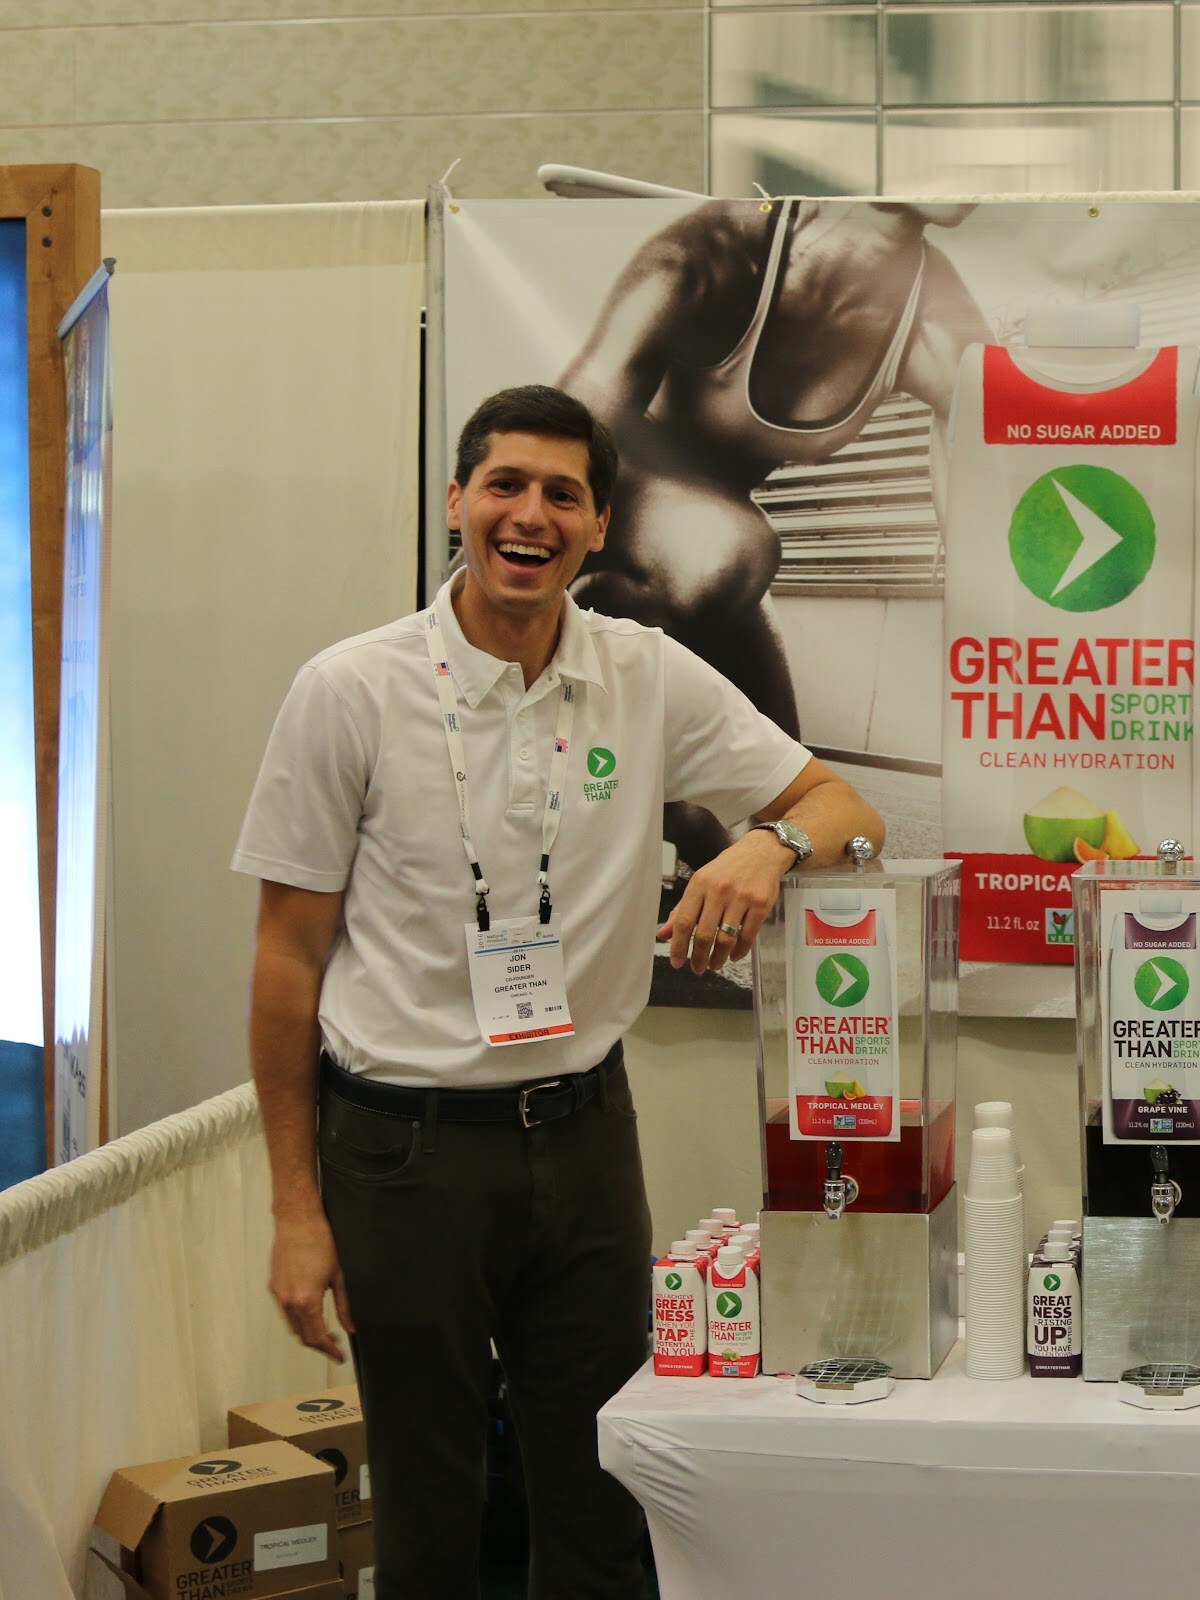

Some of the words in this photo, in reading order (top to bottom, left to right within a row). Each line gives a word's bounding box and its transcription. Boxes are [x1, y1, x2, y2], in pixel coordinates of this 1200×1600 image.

[1007, 424, 1031, 439] NO
[1036, 424, 1095, 440] SUGAR
[1101, 424, 1161, 440] ADDED
[952, 692, 1105, 742] THAN
[980, 752, 1047, 769] CLEAN
[1053, 752, 1175, 770] HYDRATION
[585, 790, 611, 801] THAN
[975, 872, 1072, 892] TROPICA
[987, 916, 1011, 930] 11.2
[1027, 919, 1040, 930] oz
[510, 954, 526, 962] JON
[507, 964, 531, 973] SIDER
[494, 982, 527, 993] GREATER
[529, 980, 547, 988] THAN
[795, 1016, 888, 1035] GREATER
[509, 1029, 550, 1040] EXHIBITOR
[797, 1037, 854, 1054] THAN
[855, 1037, 891, 1045] SPORTS
[855, 1047, 888, 1055] DRINK
[1114, 1040, 1172, 1058] THAN
[1152, 1061, 1198, 1069] HYDRATION
[808, 1102, 849, 1110] TROPICAL
[656, 1298, 694, 1310] GREAT
[1033, 1295, 1072, 1306] GREAT
[656, 1309, 695, 1322] NESS
[1033, 1306, 1072, 1318] NESS
[710, 1320, 752, 1331] GREATER
[656, 1327, 689, 1341] TAP
[711, 1330, 735, 1341] THAN
[1034, 1325, 1067, 1345] UP
[656, 1340, 695, 1348] POTENTIAL
[260, 1537, 290, 1550] TROPICAL
[292, 1535, 318, 1546] MEDLEY
[176, 1560, 253, 1590] GREATER
